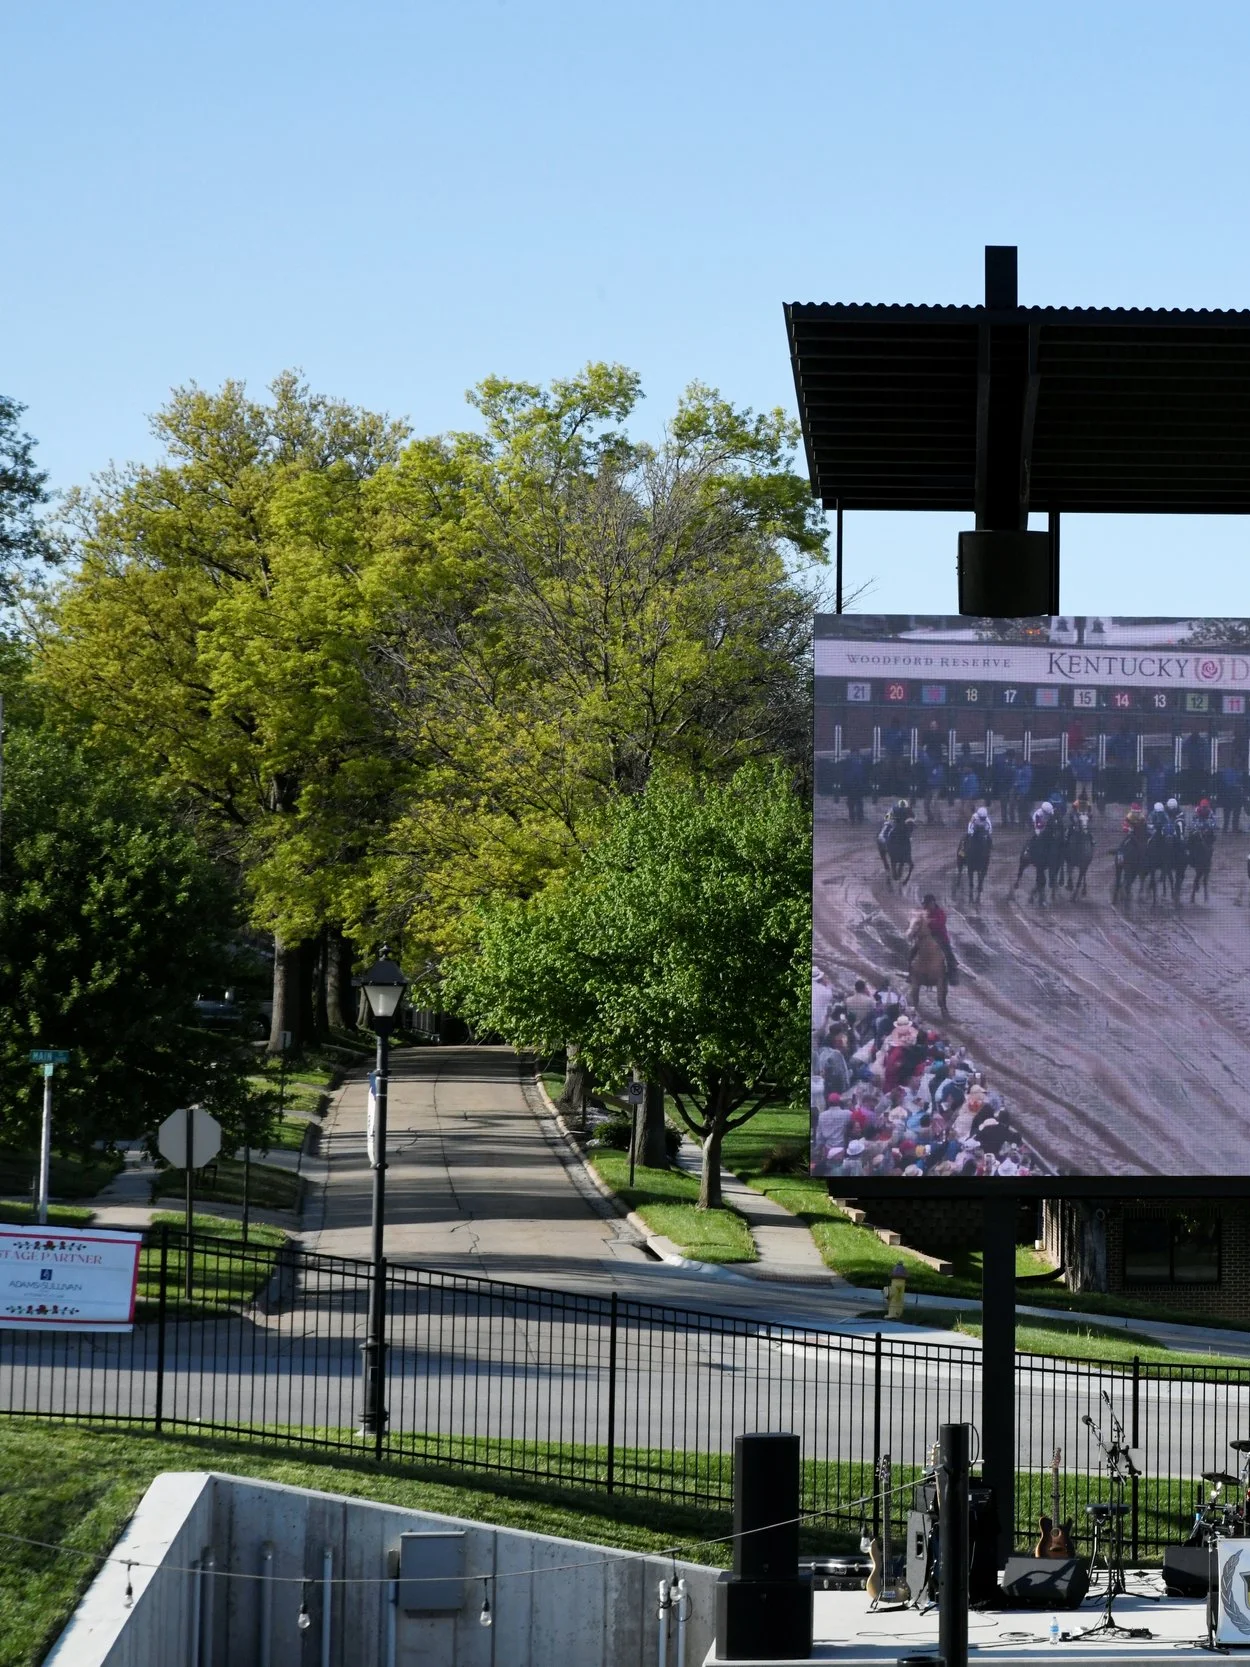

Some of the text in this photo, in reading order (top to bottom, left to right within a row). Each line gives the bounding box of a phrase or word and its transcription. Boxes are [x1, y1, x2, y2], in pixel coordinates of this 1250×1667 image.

[847, 654, 1012, 669] WOODFORD RESERVE
[1046, 652, 1190, 679] KENTUCKY
[852, 685, 866, 700] 21
[889, 685, 904, 700] 20
[965, 688, 978, 702] 18
[1003, 689, 1018, 703] 17
[1079, 691, 1092, 705] 15
[1114, 694, 1130, 707] 14
[1153, 694, 1167, 707] 13
[1190, 696, 1204, 709] 12
[0, 1249, 103, 1265] TAGE PARTNER
